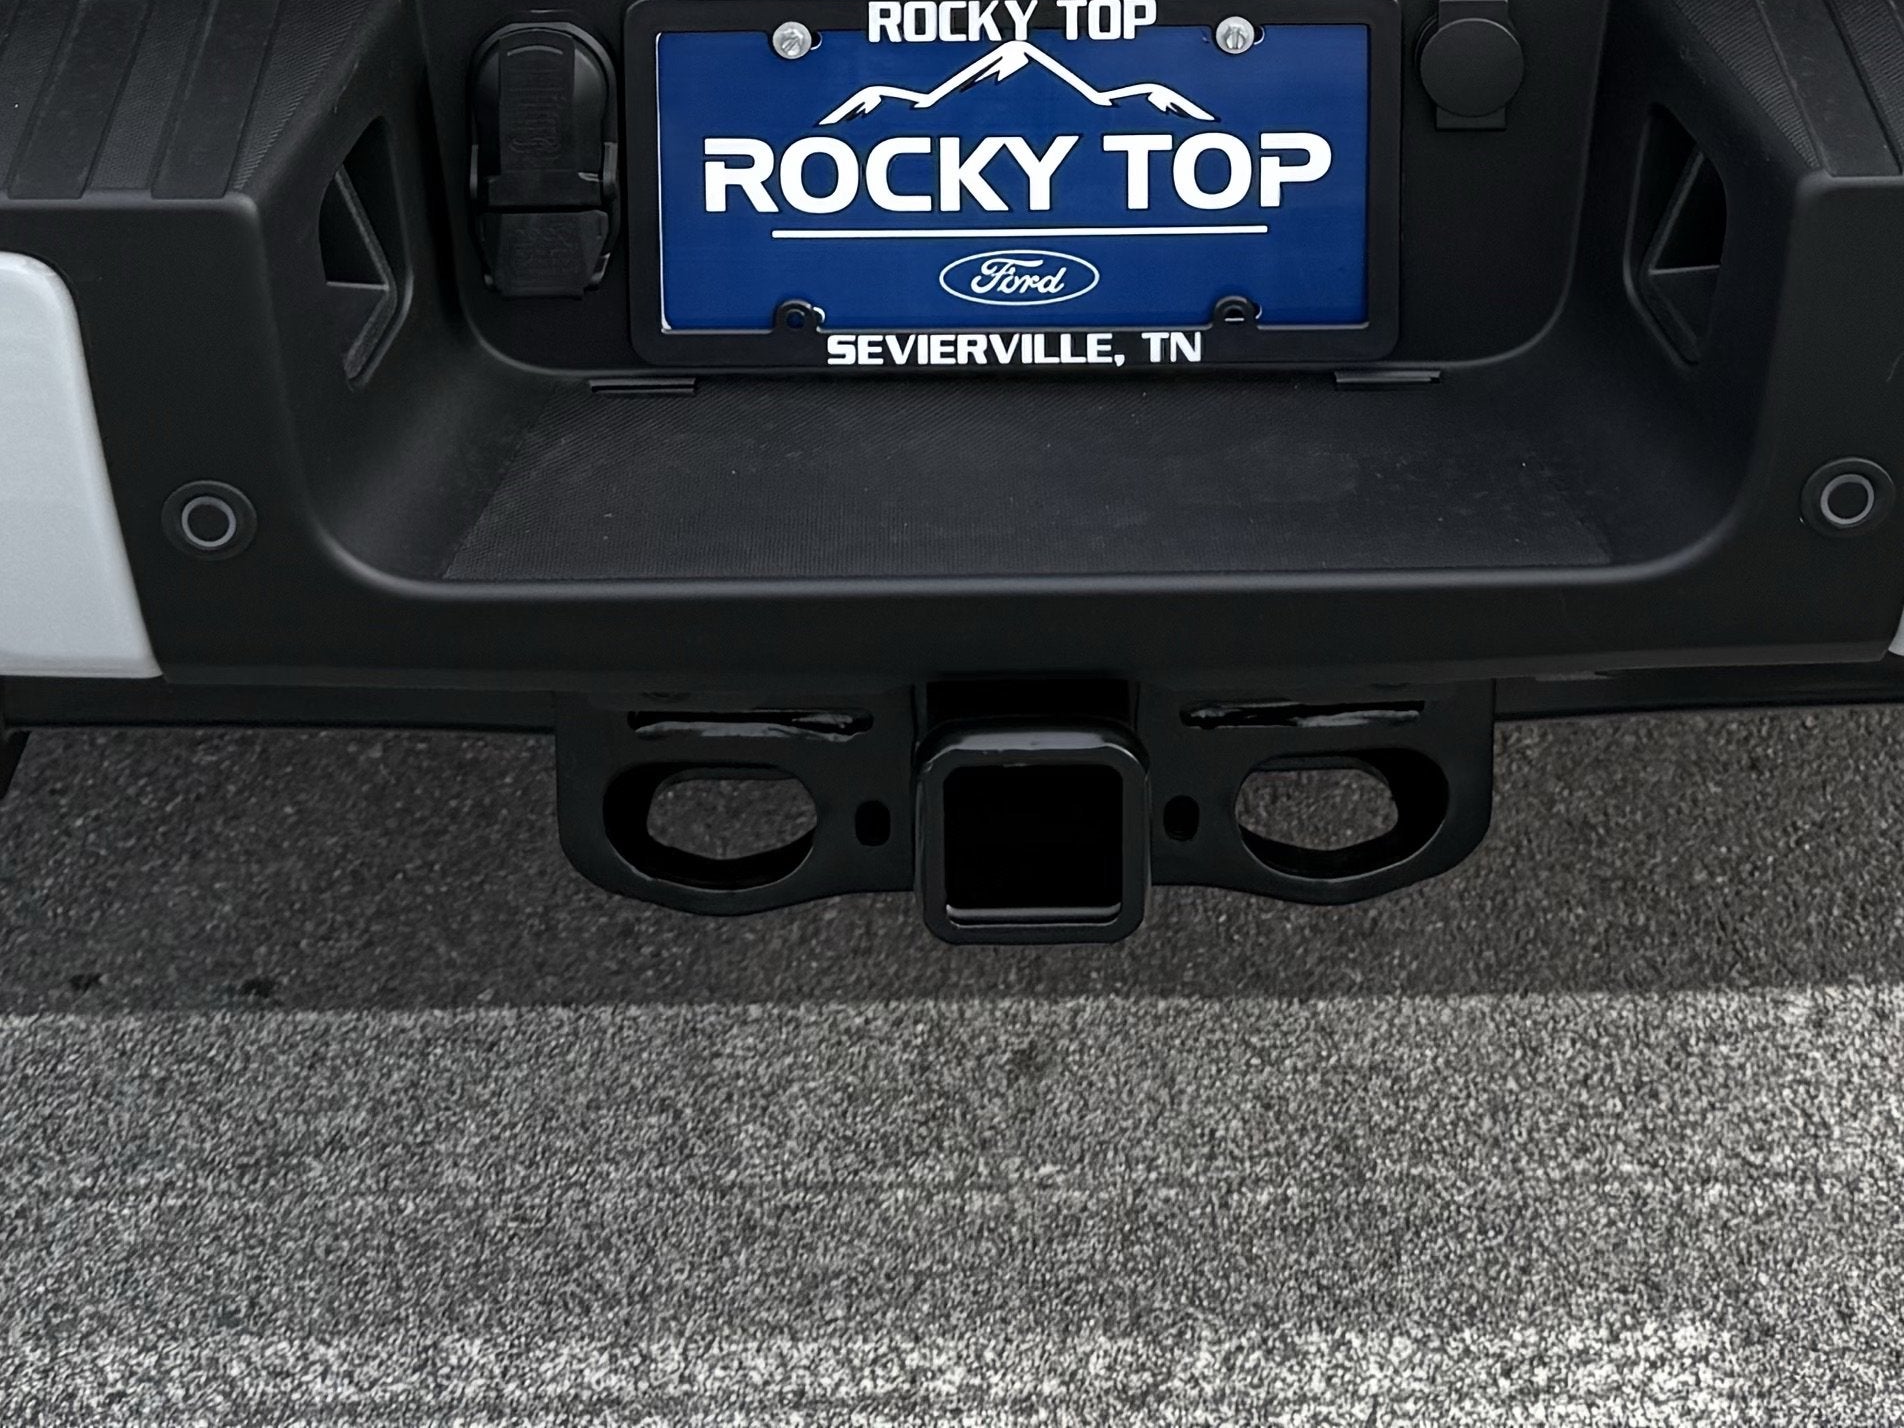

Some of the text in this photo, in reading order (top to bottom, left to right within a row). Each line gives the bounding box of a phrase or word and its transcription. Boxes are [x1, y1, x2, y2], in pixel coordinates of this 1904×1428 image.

[868, 0, 1038, 44] ROCKY
[704, 132, 1333, 214] ROCKY TOP
[970, 258, 1067, 296] Ford
[827, 331, 1201, 367] SEVIERVILLE, TN
